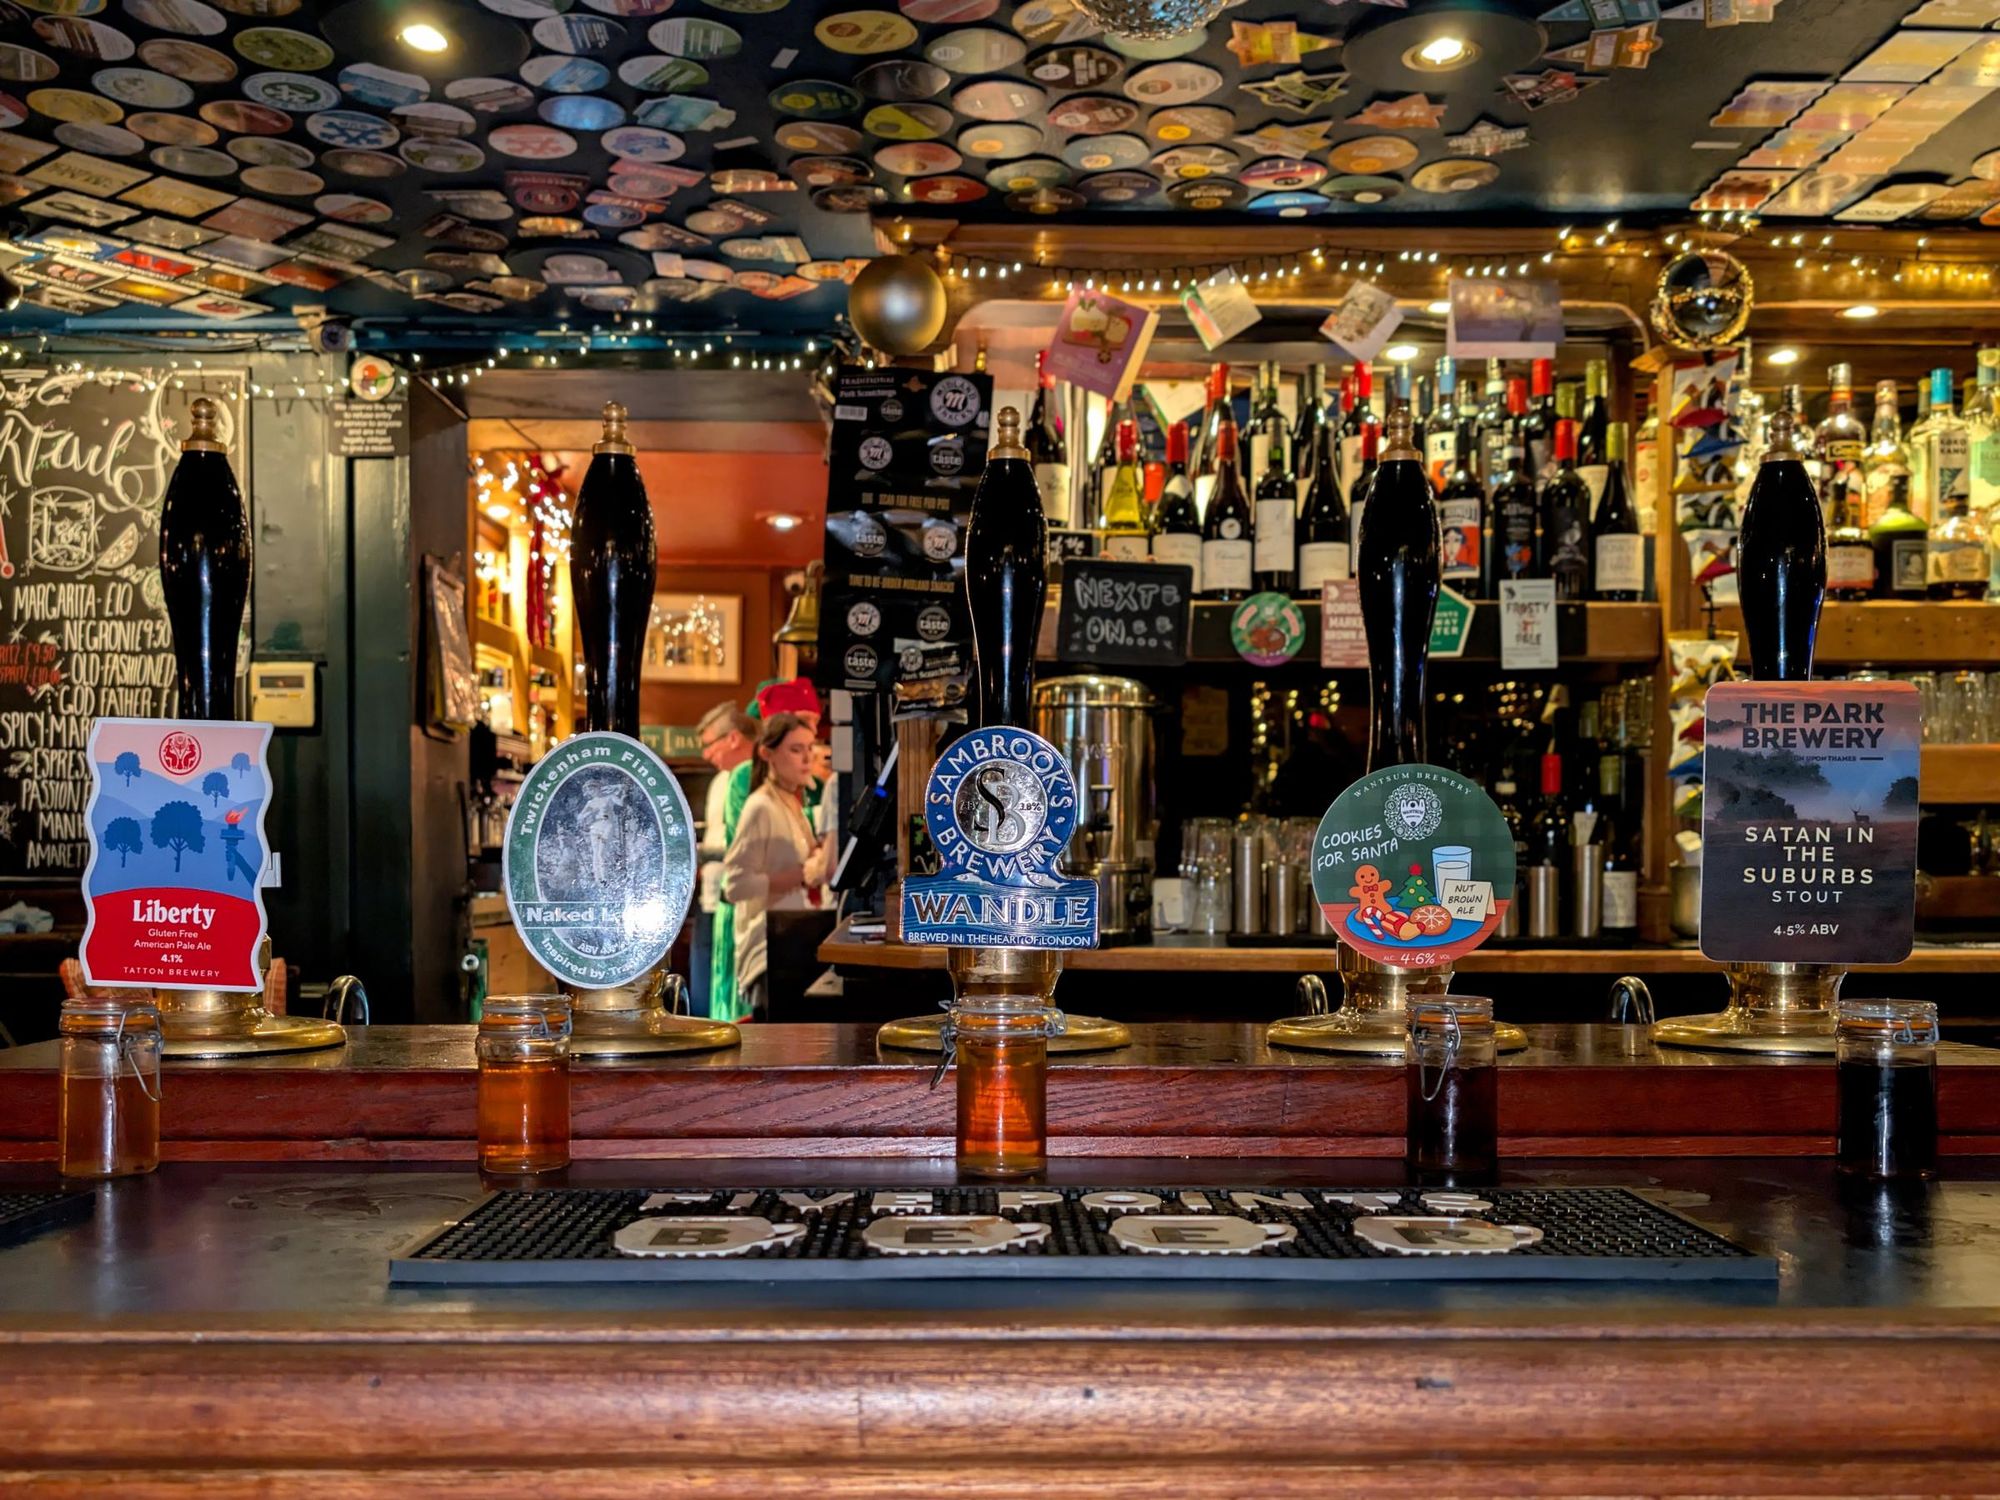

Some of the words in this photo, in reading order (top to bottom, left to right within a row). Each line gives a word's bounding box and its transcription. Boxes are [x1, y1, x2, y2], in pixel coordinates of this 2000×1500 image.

[855, 532, 885, 545] taste
[13, 582, 97, 622] MARGARITA
[1075, 577, 1159, 613] NEXT
[919, 618, 949, 630] taste
[64, 620, 134, 651] NEGRONI
[847, 655, 877, 669] taste
[59, 684, 95, 716] GOD
[100, 686, 153, 718] FATHER
[1740, 702, 1796, 724] THE
[1803, 702, 1885, 724] PARK
[0, 711, 47, 750] SPICY
[1742, 727, 1885, 749] BREWERY
[930, 734, 1073, 809] SAMBROOK'S
[520, 746, 611, 837] Twickenham
[621, 750, 657, 787] Fine
[655, 794, 680, 837] Ales
[1353, 771, 1411, 798] WANTSUM
[1416, 772, 1473, 796] BREWERY
[22, 777, 80, 812] PASSION
[1322, 824, 1382, 849] COOKIES
[1745, 827, 1832, 844] SATAN
[1846, 827, 1874, 844] IN
[937, 825, 1063, 879] BREWERY
[1317, 851, 1345, 872] FOR
[1351, 837, 1399, 862] SANTA
[1783, 846, 1835, 863] THE
[1743, 867, 1874, 886] SUBURBS
[1455, 884, 1476, 893] NUT
[1771, 890, 1844, 904] STOUT
[1448, 894, 1484, 905] BROWN
[132, 899, 216, 930] Liberty
[525, 906, 594, 922] Naked
[909, 889, 1093, 929] WANDLE
[1456, 905, 1476, 915] ALE
[148, 928, 177, 938] Gluten
[179, 928, 199, 939] Free
[908, 932, 949, 944] BREWED
[951, 933, 965, 944] IN
[966, 933, 988, 944] THE
[989, 934, 1022, 945] HEART
[1024, 936, 1040, 946] OF
[1041, 935, 1092, 947] LONDON
[1773, 925, 1806, 937] 4.5%
[1809, 925, 1840, 936] ABV
[134, 939, 175, 949] American
[177, 940, 196, 950] Pale
[197, 941, 212, 951] Ale
[160, 953, 184, 964] 4.1%
[123, 966, 165, 976] TATTON
[168, 968, 221, 978] BREWERY
[589, 968, 606, 980] by
